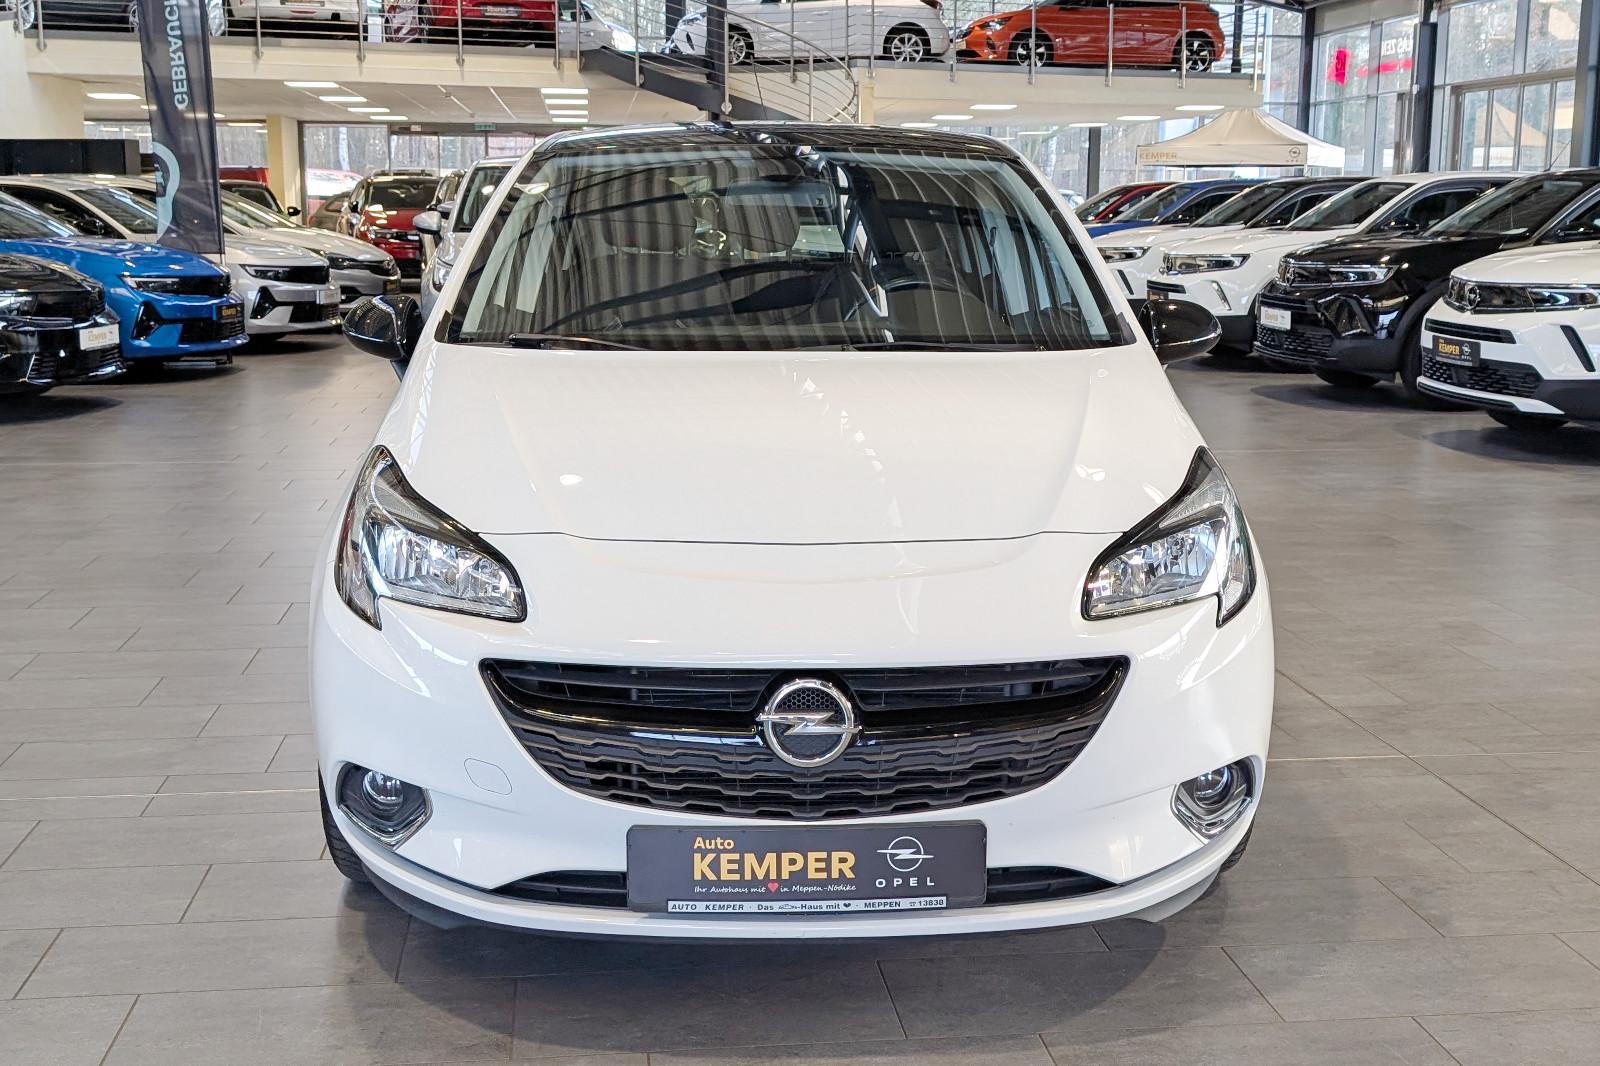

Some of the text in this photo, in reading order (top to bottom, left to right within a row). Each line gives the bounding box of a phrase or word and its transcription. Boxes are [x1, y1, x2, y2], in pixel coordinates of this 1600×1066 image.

[1139, 152, 1177, 160] KEMPER
[1439, 343, 1460, 355] KEMPER
[693, 836, 735, 850] Auto
[693, 851, 856, 881] KEMPER
[875, 877, 935, 888] OPEL
[694, 884, 857, 894] Ihr Autohaus mit in Meppen-Nödike
[671, 903, 697, 911] AUTO
[705, 903, 744, 911] KEMPER
[757, 903, 774, 911] Das
[826, 902, 840, 910] mit
[864, 901, 901, 909] MEPPEN
[919, 899, 944, 907] 13838
